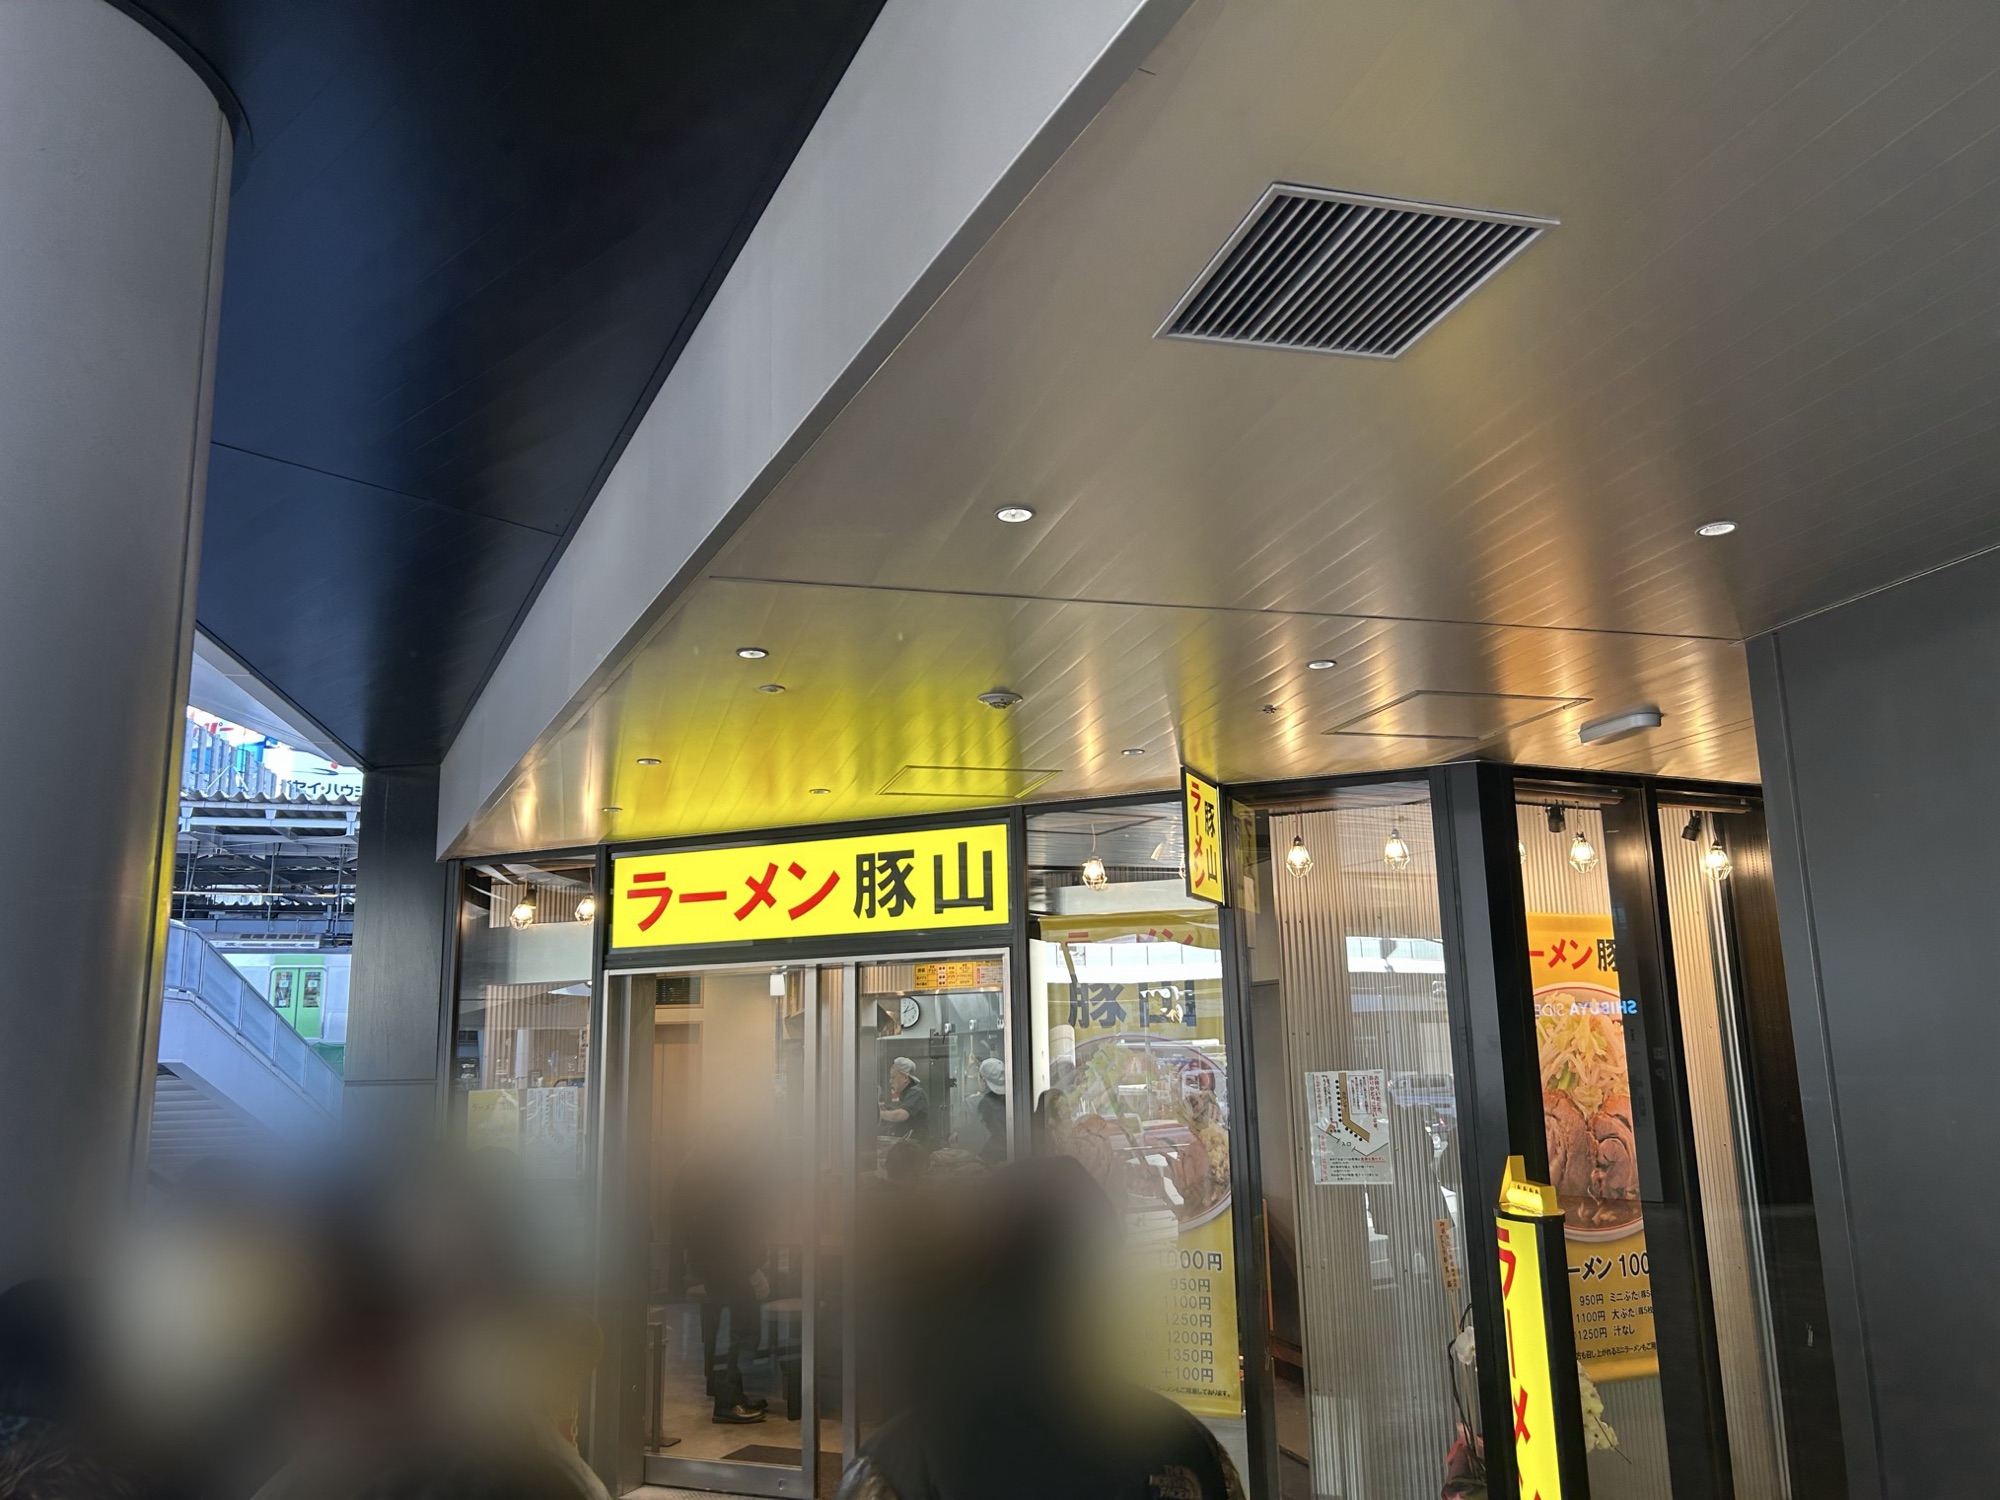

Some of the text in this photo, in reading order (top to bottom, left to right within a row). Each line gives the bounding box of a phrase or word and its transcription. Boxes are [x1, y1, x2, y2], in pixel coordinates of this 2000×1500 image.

[1190, 781, 1205, 889] ラーメン
[1204, 800, 1217, 883] 豚山
[627, 841, 994, 932] ラーメン豚山
[1170, 1277, 1210, 1293] 950円
[1580, 1293, 1604, 1306] 950円
[1576, 1310, 1606, 1323] 1100円
[1167, 1330, 1213, 1347] 1200円
[1613, 1324, 1635, 1337] 汁なし
[1166, 1347, 1214, 1365] 1350円
[1497, 1226, 1541, 1500] ラーメ
